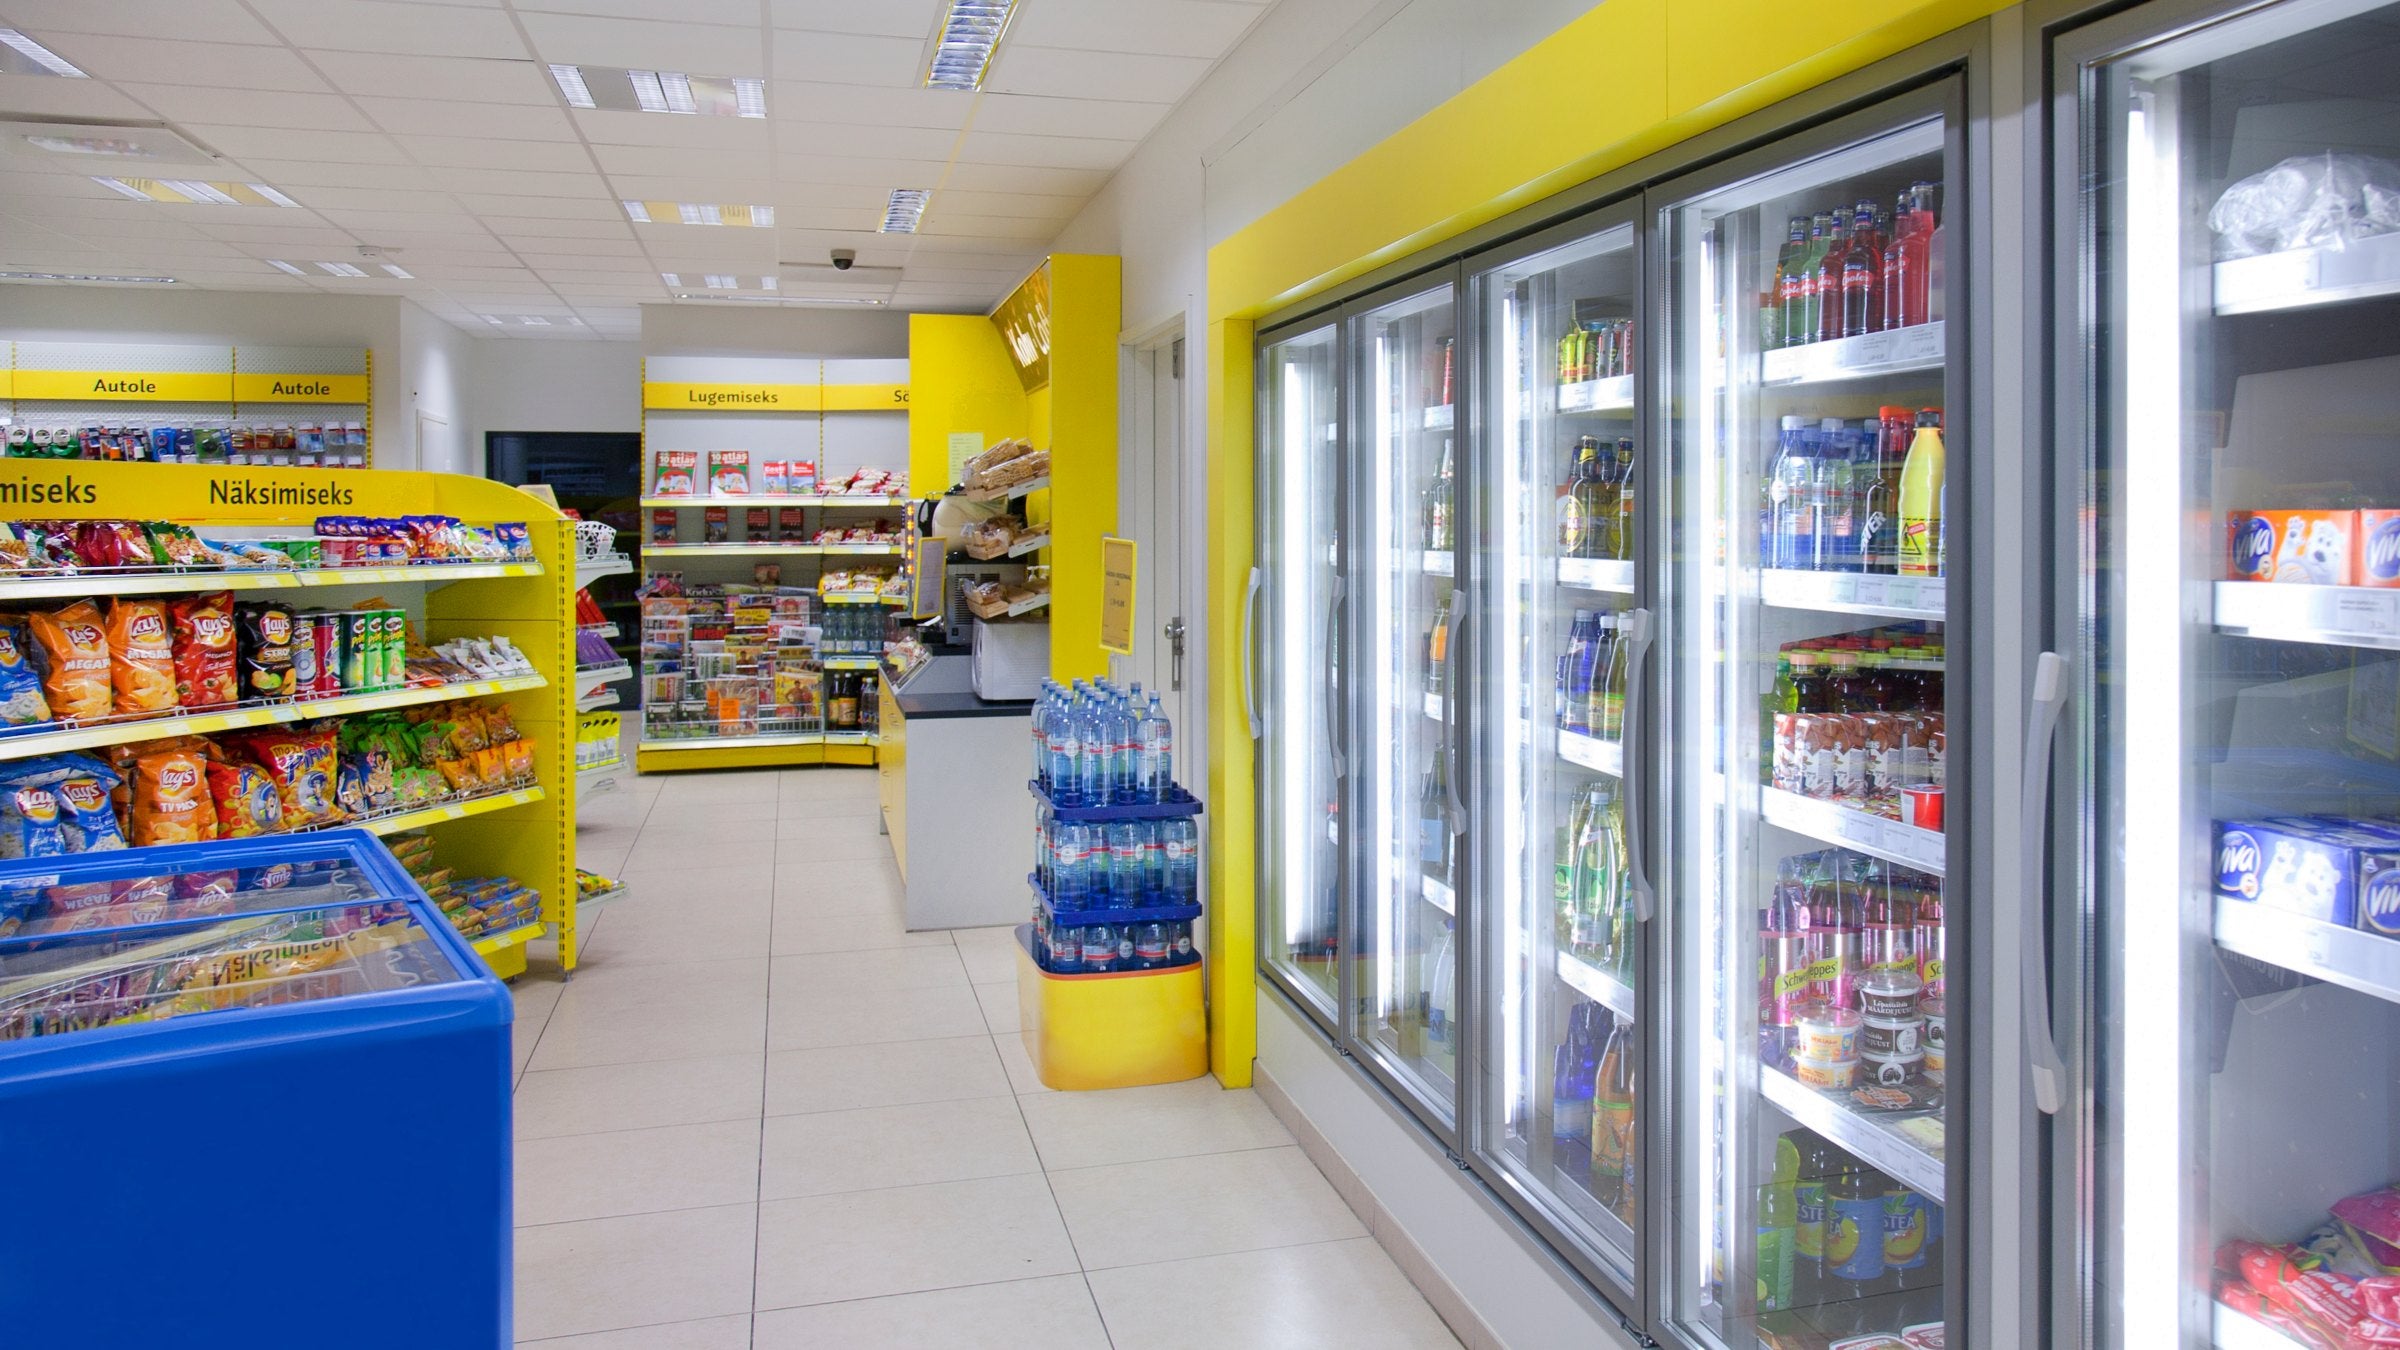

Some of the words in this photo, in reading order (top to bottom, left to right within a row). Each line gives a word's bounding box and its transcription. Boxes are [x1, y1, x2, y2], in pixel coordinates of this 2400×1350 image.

[94, 378, 156, 394] Autole
[271, 381, 331, 396] Autole
[688, 389, 779, 405] Lugemiseks
[210, 478, 354, 505] Näksimiseks
